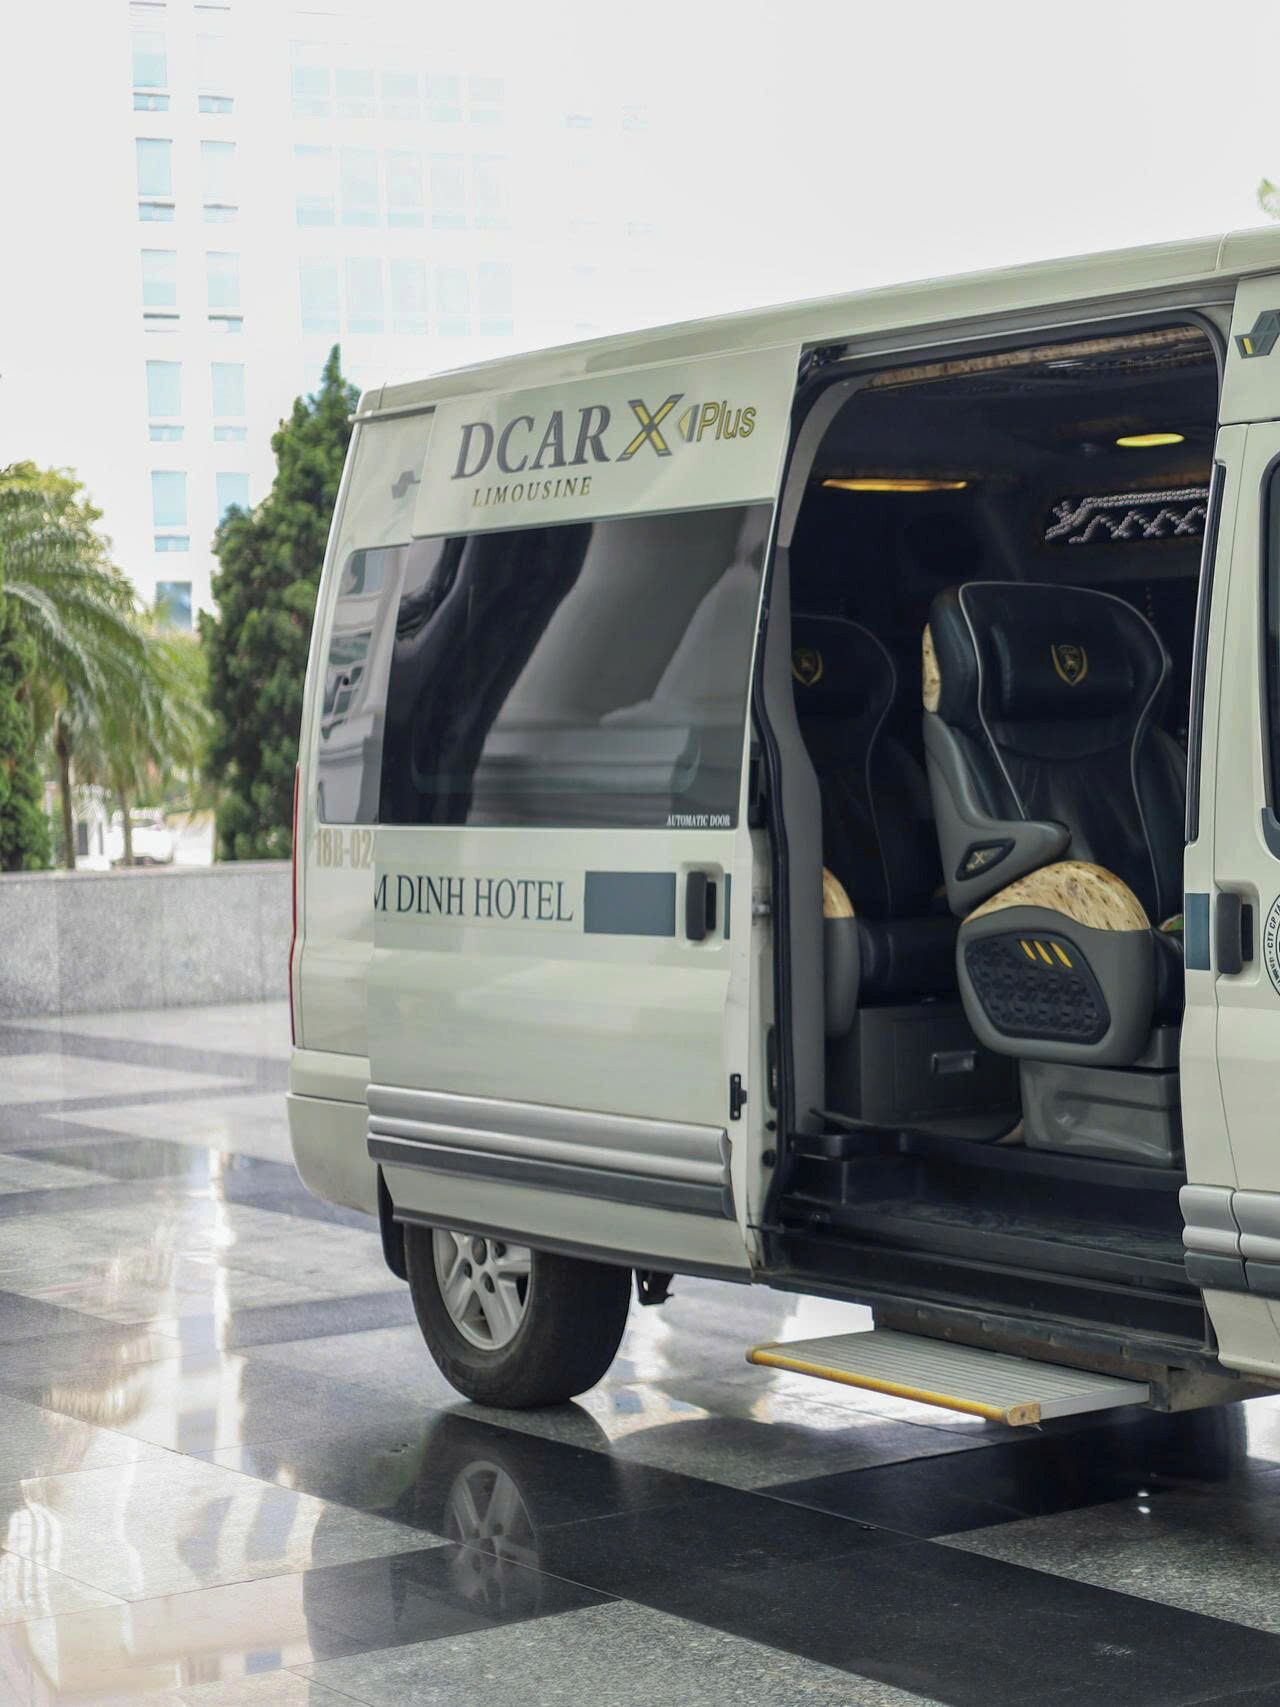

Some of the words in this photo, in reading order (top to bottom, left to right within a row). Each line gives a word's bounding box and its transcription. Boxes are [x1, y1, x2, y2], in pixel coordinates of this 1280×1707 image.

[450, 404, 611, 480] DCAR
[616, 393, 686, 463] X
[696, 399, 757, 442] Plus
[472, 475, 593, 507] LIMOUSINE
[666, 813, 709, 827] AUTOMATIC
[709, 813, 731, 827] DOOR
[397, 874, 464, 916] DINH
[473, 877, 574, 921] HOTEL
[1269, 916, 1277, 930] CP
